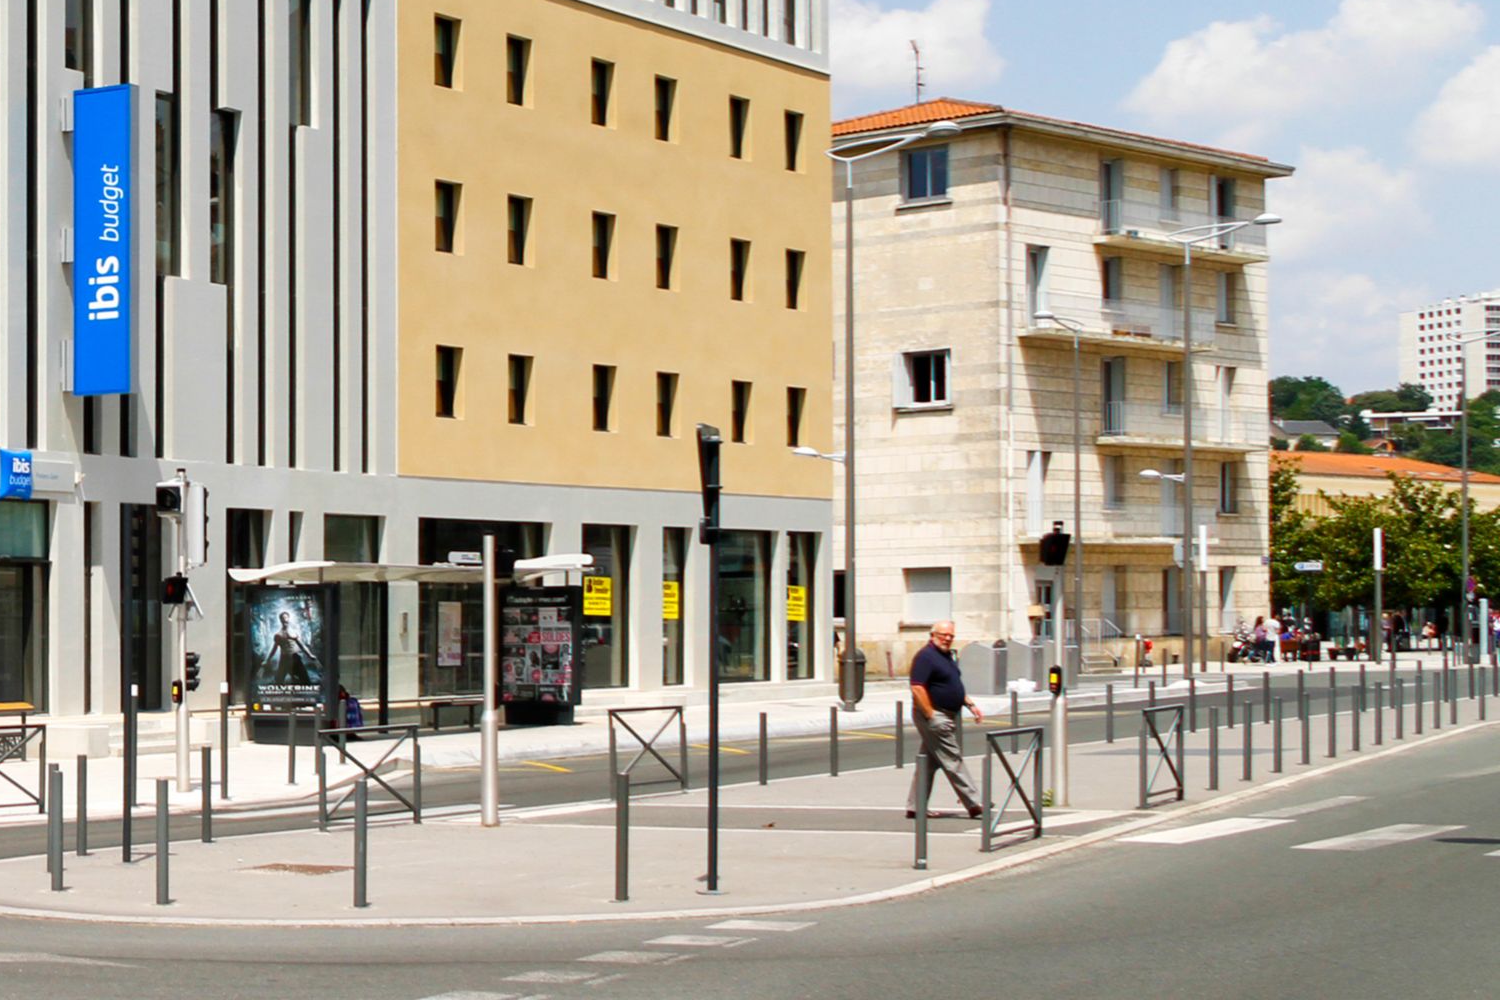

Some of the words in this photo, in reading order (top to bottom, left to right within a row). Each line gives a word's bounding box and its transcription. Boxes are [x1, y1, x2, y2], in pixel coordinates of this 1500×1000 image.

[99, 164, 124, 242] budget
[88, 256, 119, 321] ibis
[9, 474, 31, 487] budge
[12, 457, 30, 474] ibis
